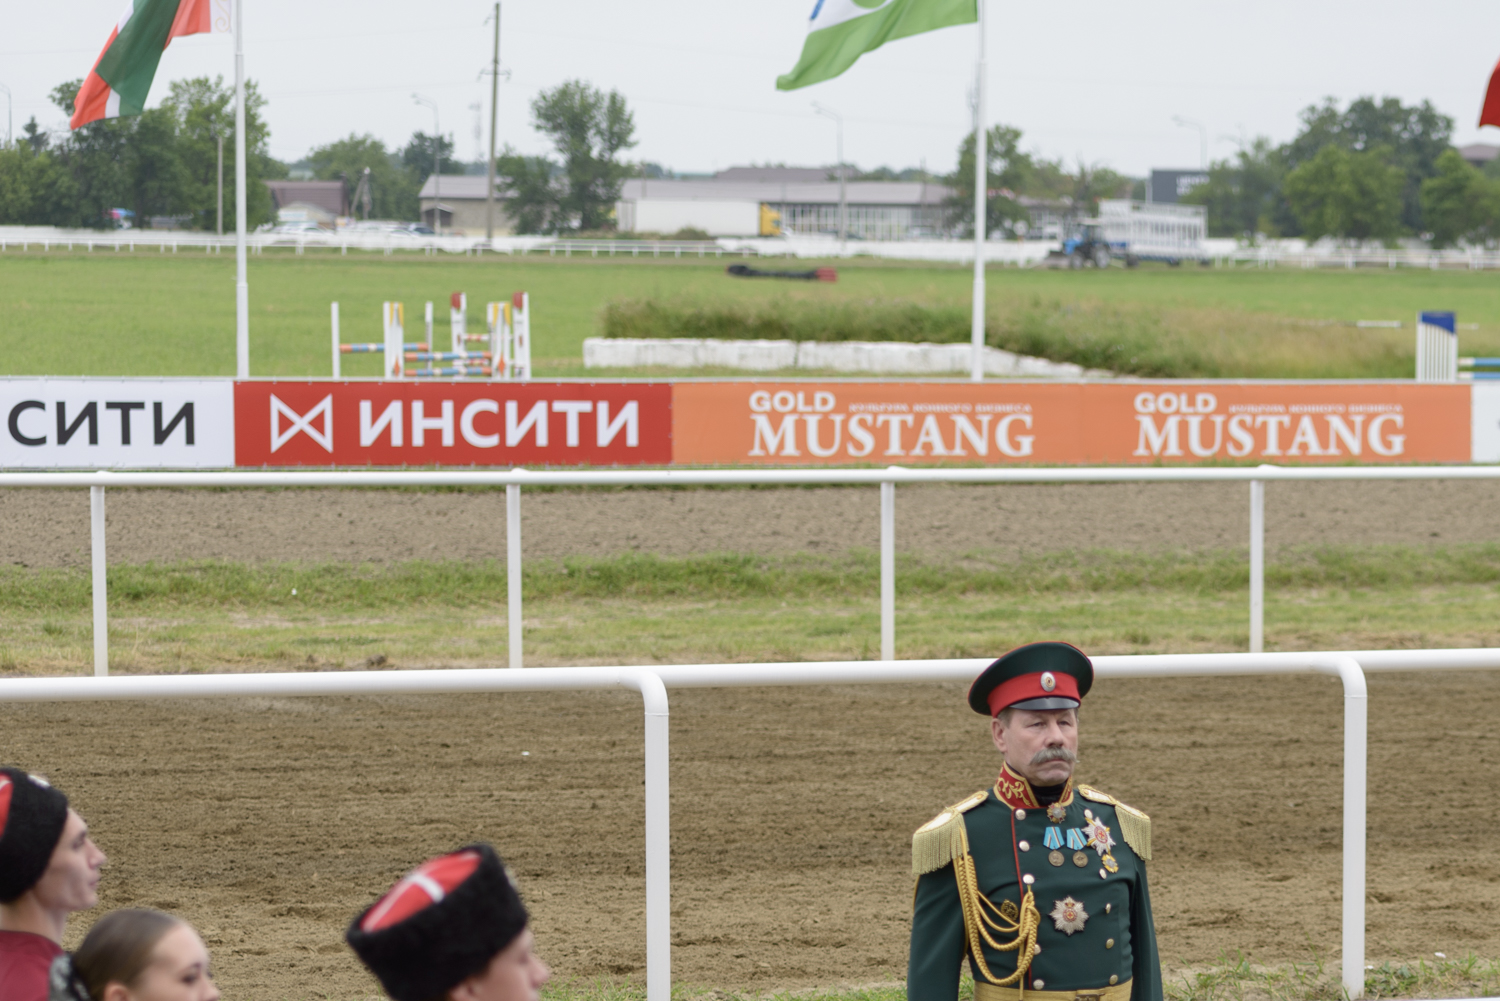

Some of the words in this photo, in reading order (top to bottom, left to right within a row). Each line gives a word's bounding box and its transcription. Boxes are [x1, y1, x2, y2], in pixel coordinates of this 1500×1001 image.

[359, 398, 639, 448] ИНСИТИ
[749, 390, 836, 413] GOLD
[1134, 391, 1218, 414] GOLD
[748, 413, 1035, 457] MUSTANG
[1133, 414, 1406, 457] MUSTANG
